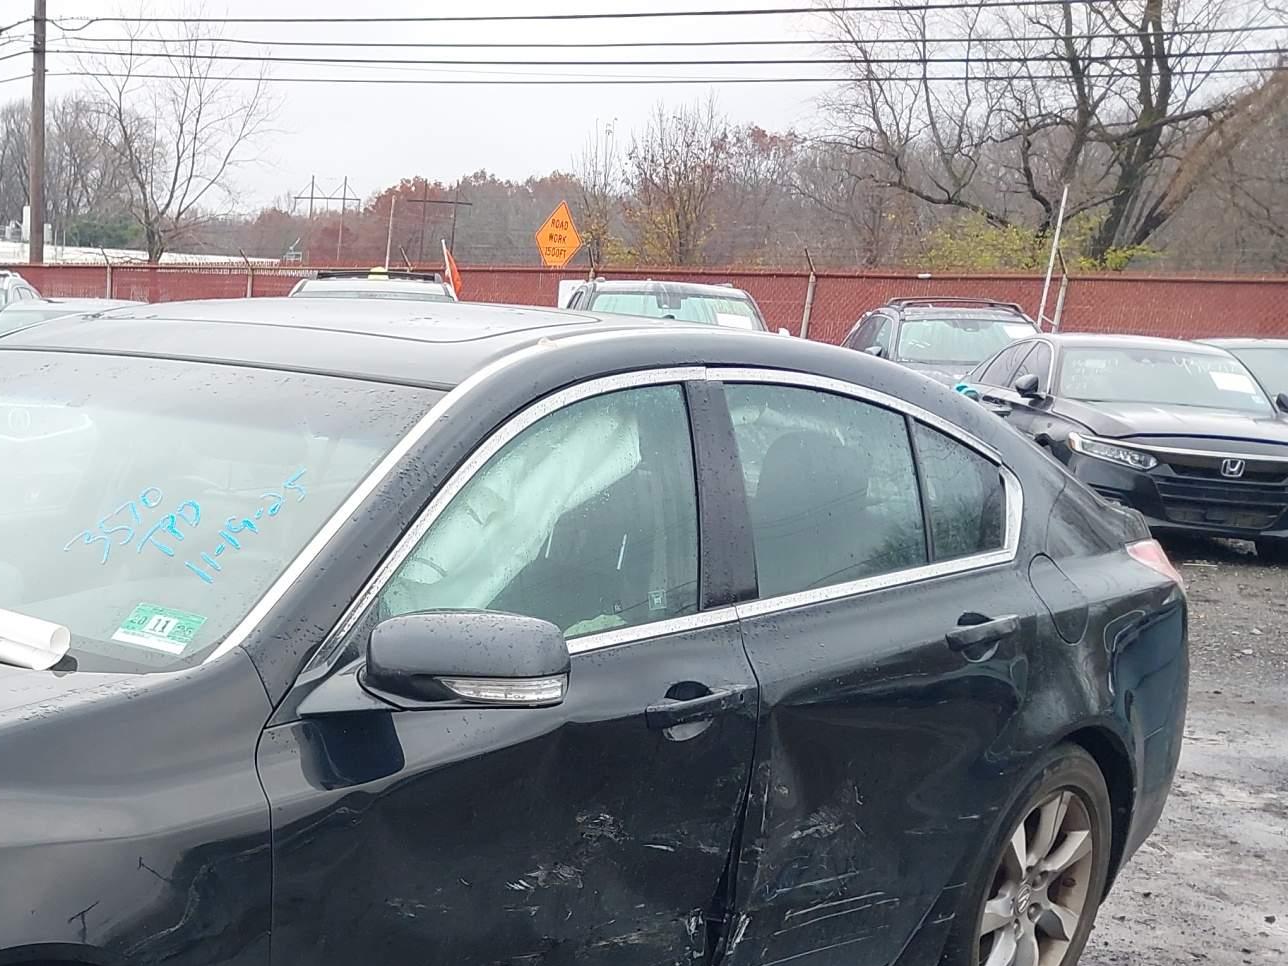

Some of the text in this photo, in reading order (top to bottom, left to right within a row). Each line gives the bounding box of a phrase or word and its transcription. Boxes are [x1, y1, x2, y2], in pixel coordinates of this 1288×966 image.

[550, 218, 569, 231] ROAD
[548, 232, 567, 244] WORK
[63, 487, 163, 565] 3570
[148, 618, 171, 633] 11
